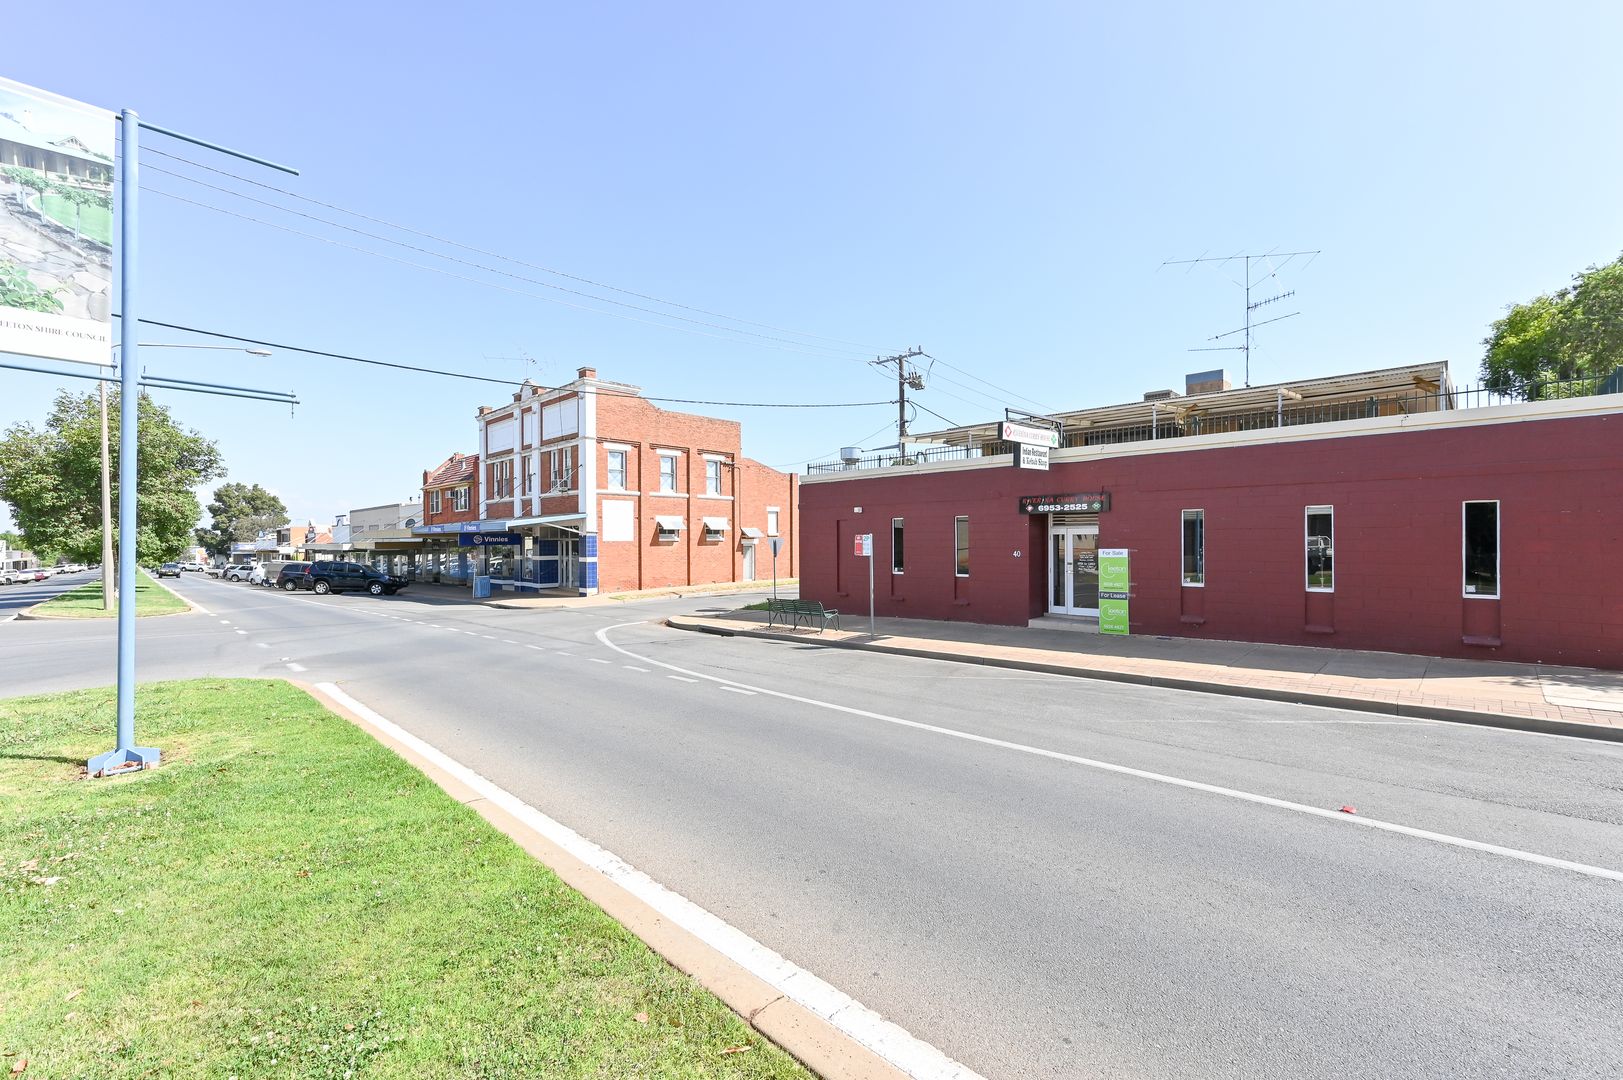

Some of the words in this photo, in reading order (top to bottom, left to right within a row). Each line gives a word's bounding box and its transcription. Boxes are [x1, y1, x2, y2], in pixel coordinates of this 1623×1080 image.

[35, 325, 63, 335] SHIRE
[65, 330, 107, 342] COUNCIL
[1013, 550, 1021, 558] 40
